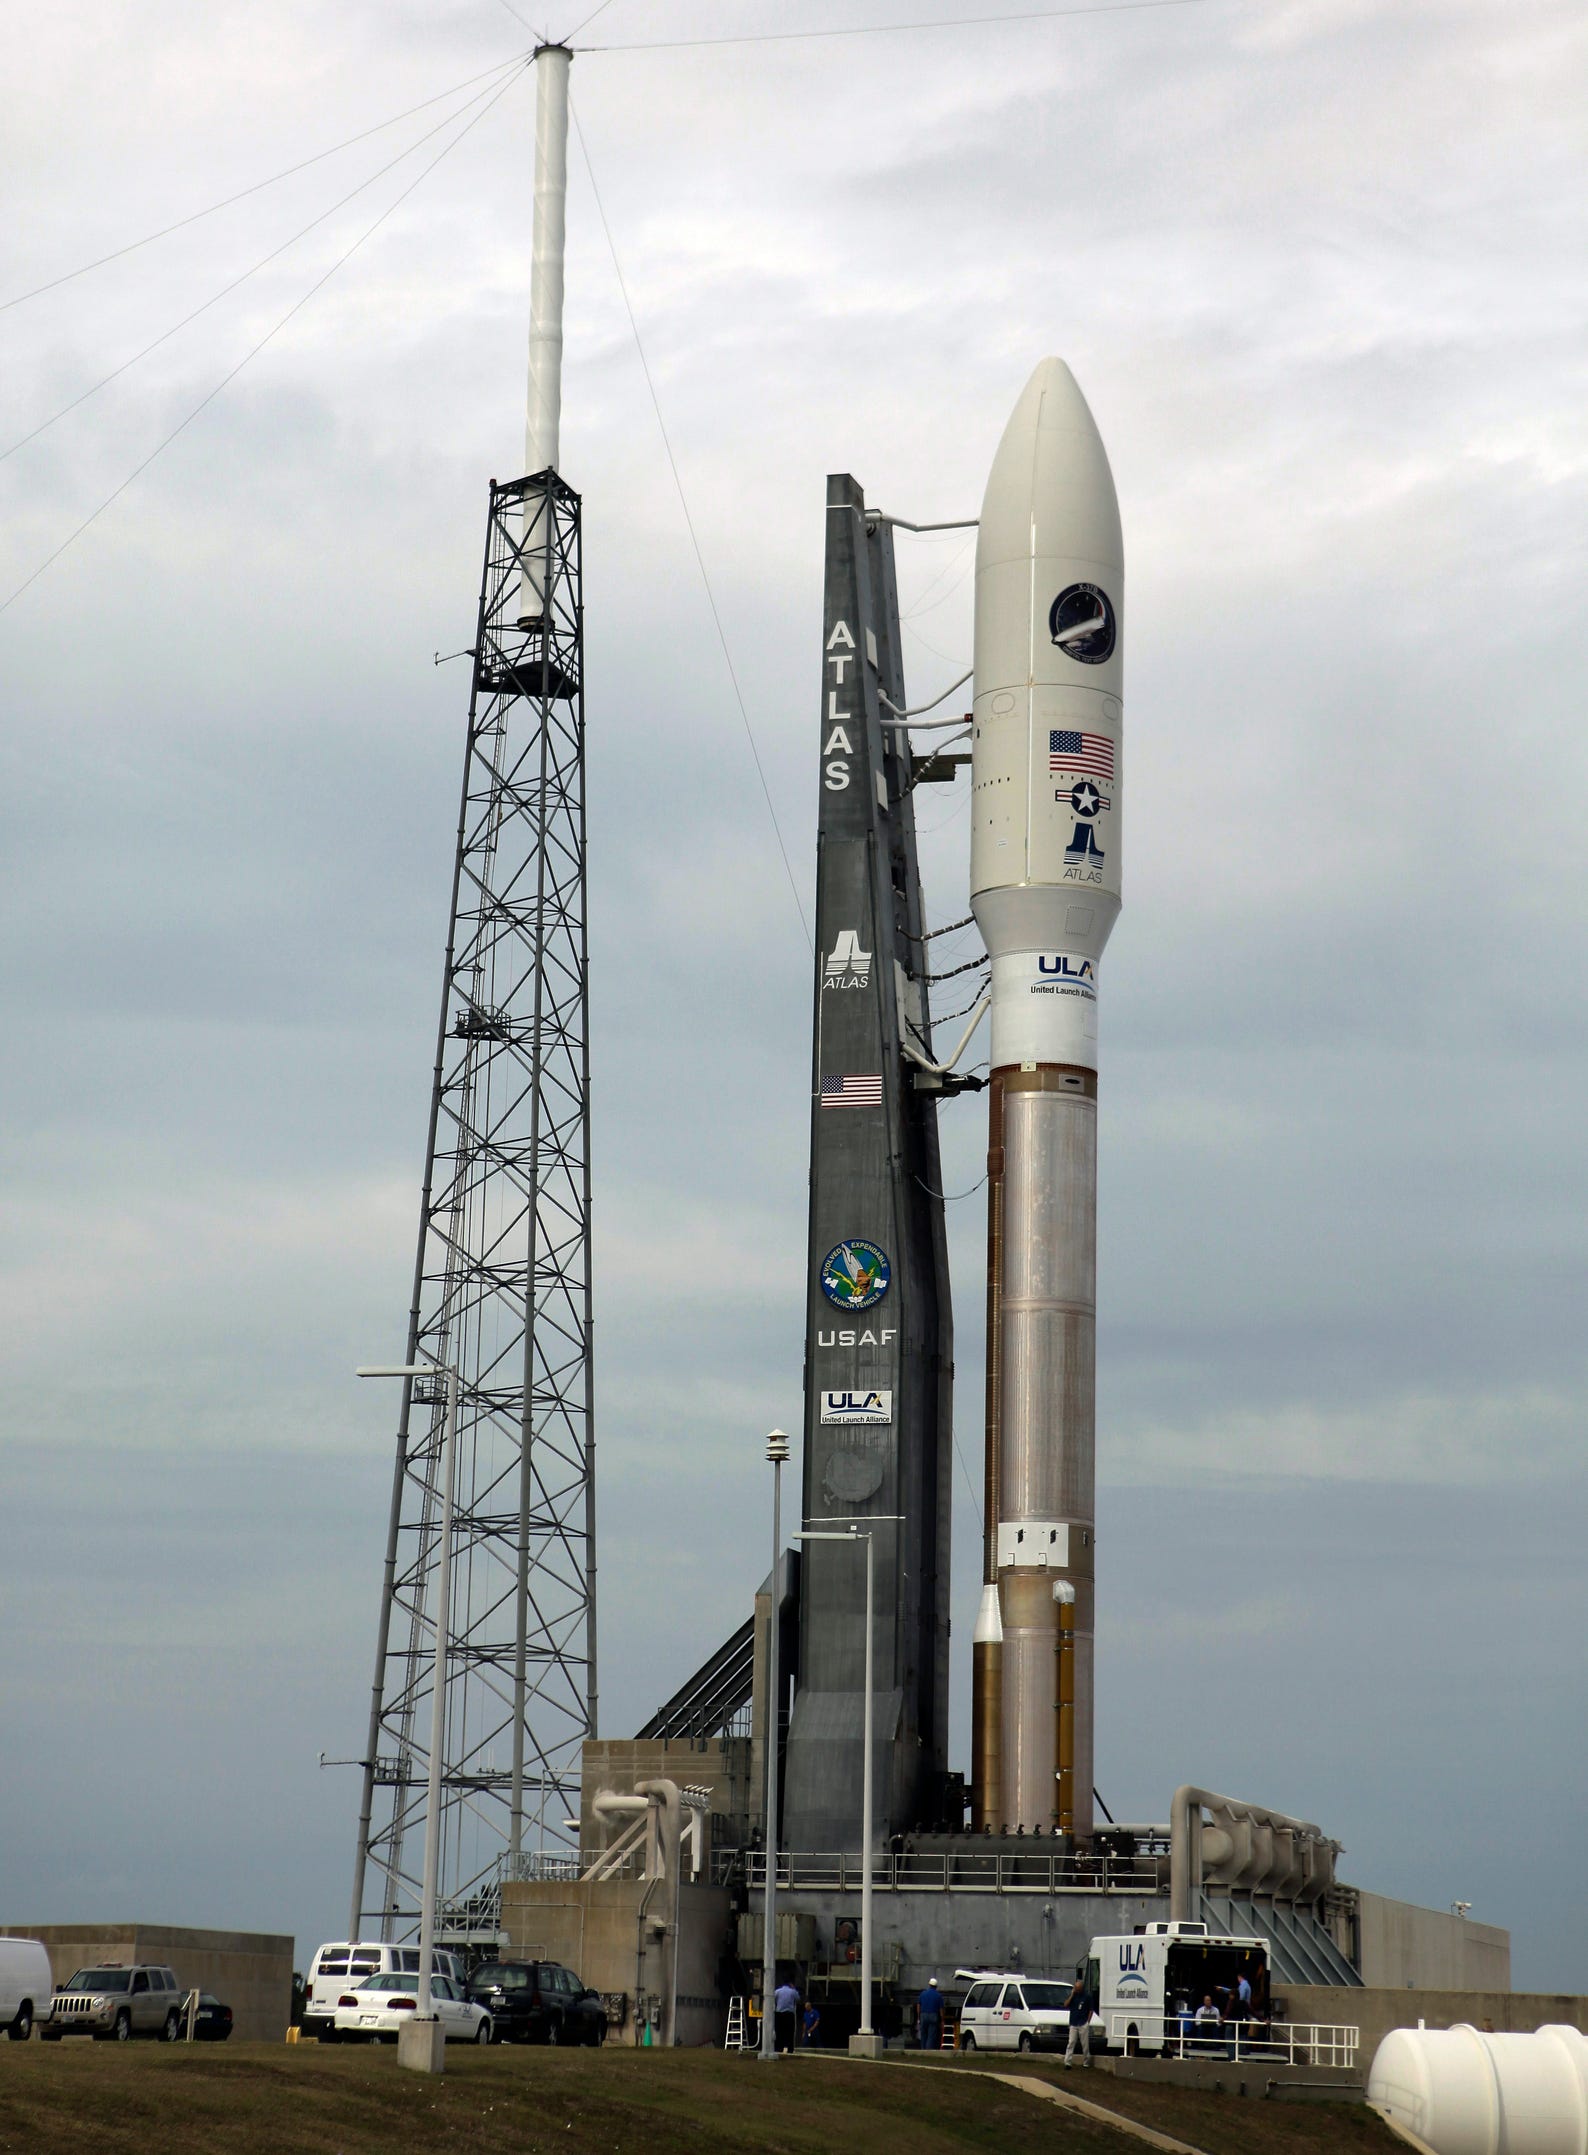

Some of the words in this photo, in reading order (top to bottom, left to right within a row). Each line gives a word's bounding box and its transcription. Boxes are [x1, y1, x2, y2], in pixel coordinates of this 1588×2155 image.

[823, 620, 856, 791] ATLAS
[1063, 868, 1103, 884] ATLAS
[1039, 956, 1094, 981] ULA
[823, 975, 870, 990] ATLAS
[1031, 986, 1055, 994] United
[1056, 986, 1080, 997] Launch
[823, 1247, 842, 1277] EVOLVED
[851, 1242, 887, 1269] EXPENDABLE
[830, 1293, 855, 1309] LAUNCH
[856, 1291, 881, 1309] VEHICLE
[818, 1329, 897, 1347] USAF
[828, 1393, 883, 1408] ULA
[821, 1416, 842, 1424] United
[1119, 1943, 1146, 1971] ULA
